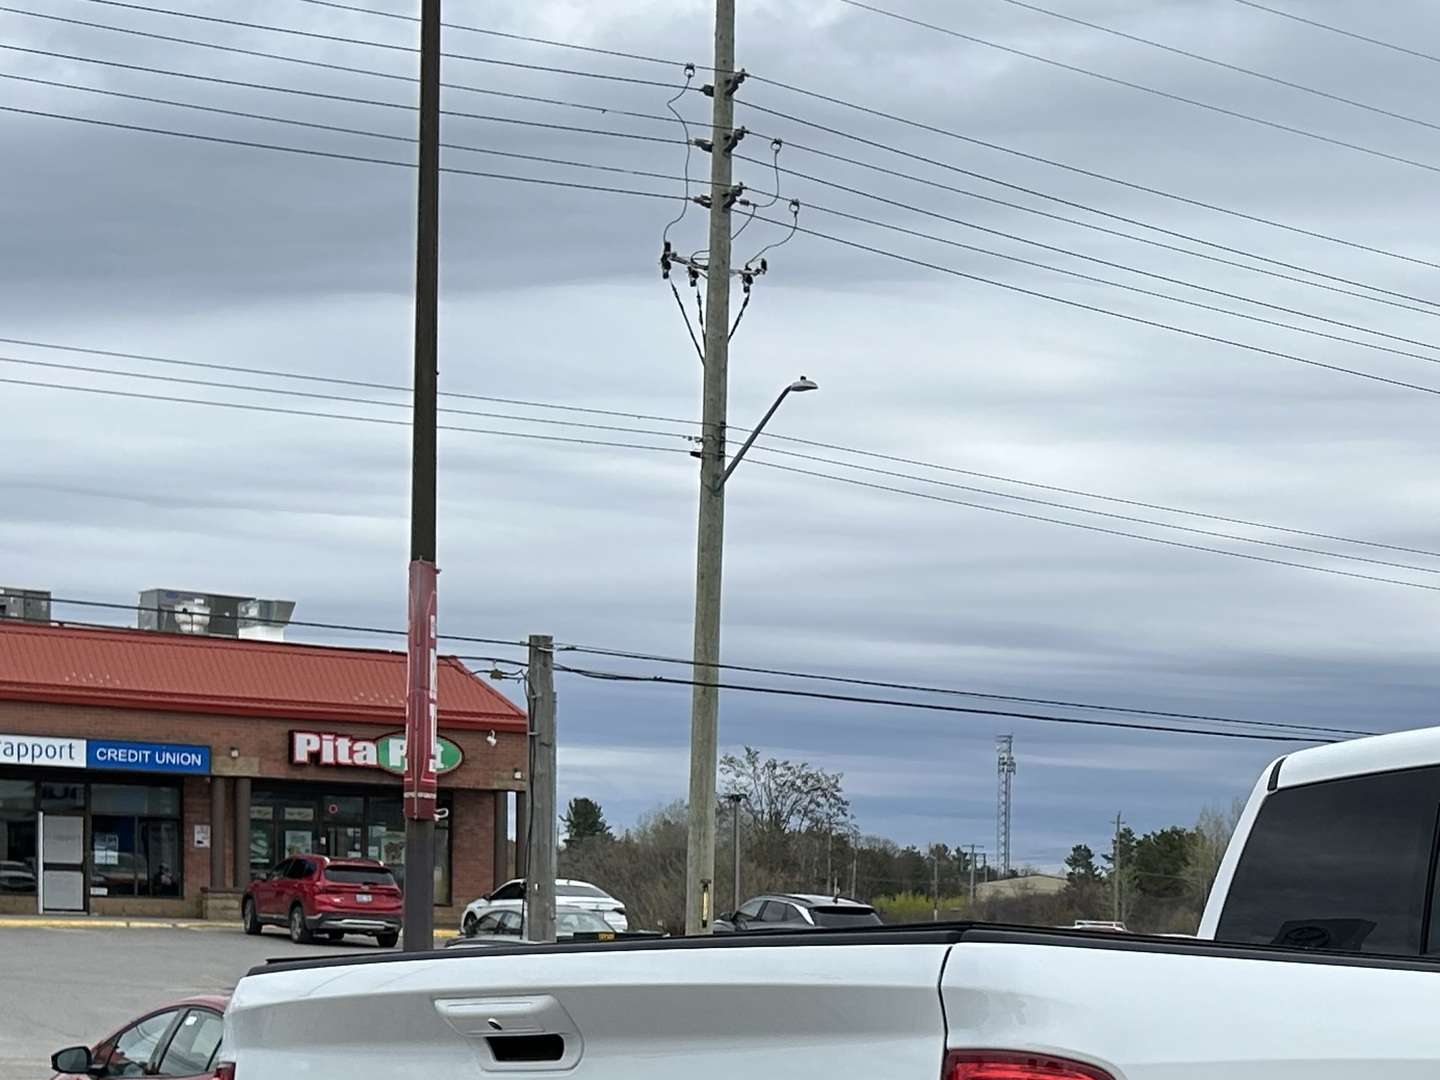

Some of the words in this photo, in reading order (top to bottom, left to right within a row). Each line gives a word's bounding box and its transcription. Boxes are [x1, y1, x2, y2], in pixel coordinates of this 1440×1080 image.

[0, 741, 75, 763] apport
[96, 748, 151, 764] CREDIT
[155, 752, 202, 766] UNION
[293, 732, 378, 765] Pita
[388, 738, 444, 769] Pt
